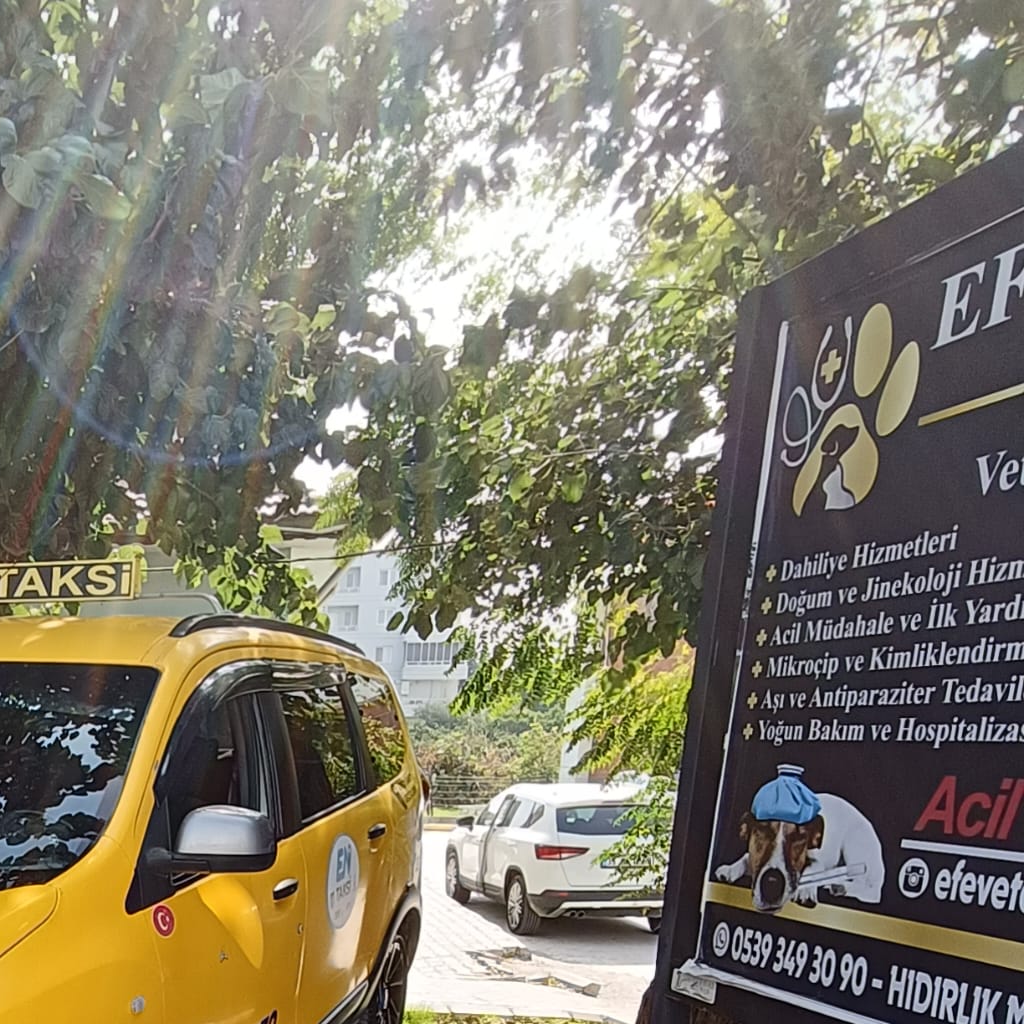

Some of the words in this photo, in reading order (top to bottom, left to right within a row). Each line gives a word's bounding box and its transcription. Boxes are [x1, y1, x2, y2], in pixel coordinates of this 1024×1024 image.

[780, 551, 847, 582] Dahiliye
[852, 524, 959, 568] Hizmetleri
[776, 589, 832, 617] Doğum
[838, 585, 857, 605] ve
[861, 562, 962, 602] Jinekoloji
[770, 622, 801, 646] Acil
[804, 611, 894, 642] Müdahale
[900, 611, 921, 631] ve
[926, 598, 958, 629] İlk
[761, 689, 784, 713] Aşı
[789, 691, 806, 708] ve
[809, 681, 936, 713] Antiparaziter
[941, 674, 1024, 704] Tedavil
[766, 652, 839, 680] Mikroçip
[845, 654, 864, 672] ve
[758, 720, 803, 746] Yoğun
[808, 719, 867, 742] Bakım
[871, 724, 891, 742] ve
[913, 775, 1024, 840] Acil
[934, 859, 1024, 914] efevet
[731, 925, 773, 970] 0539
[773, 936, 808, 979] 349
[808, 944, 835, 988] 30
[840, 952, 867, 996] 90
